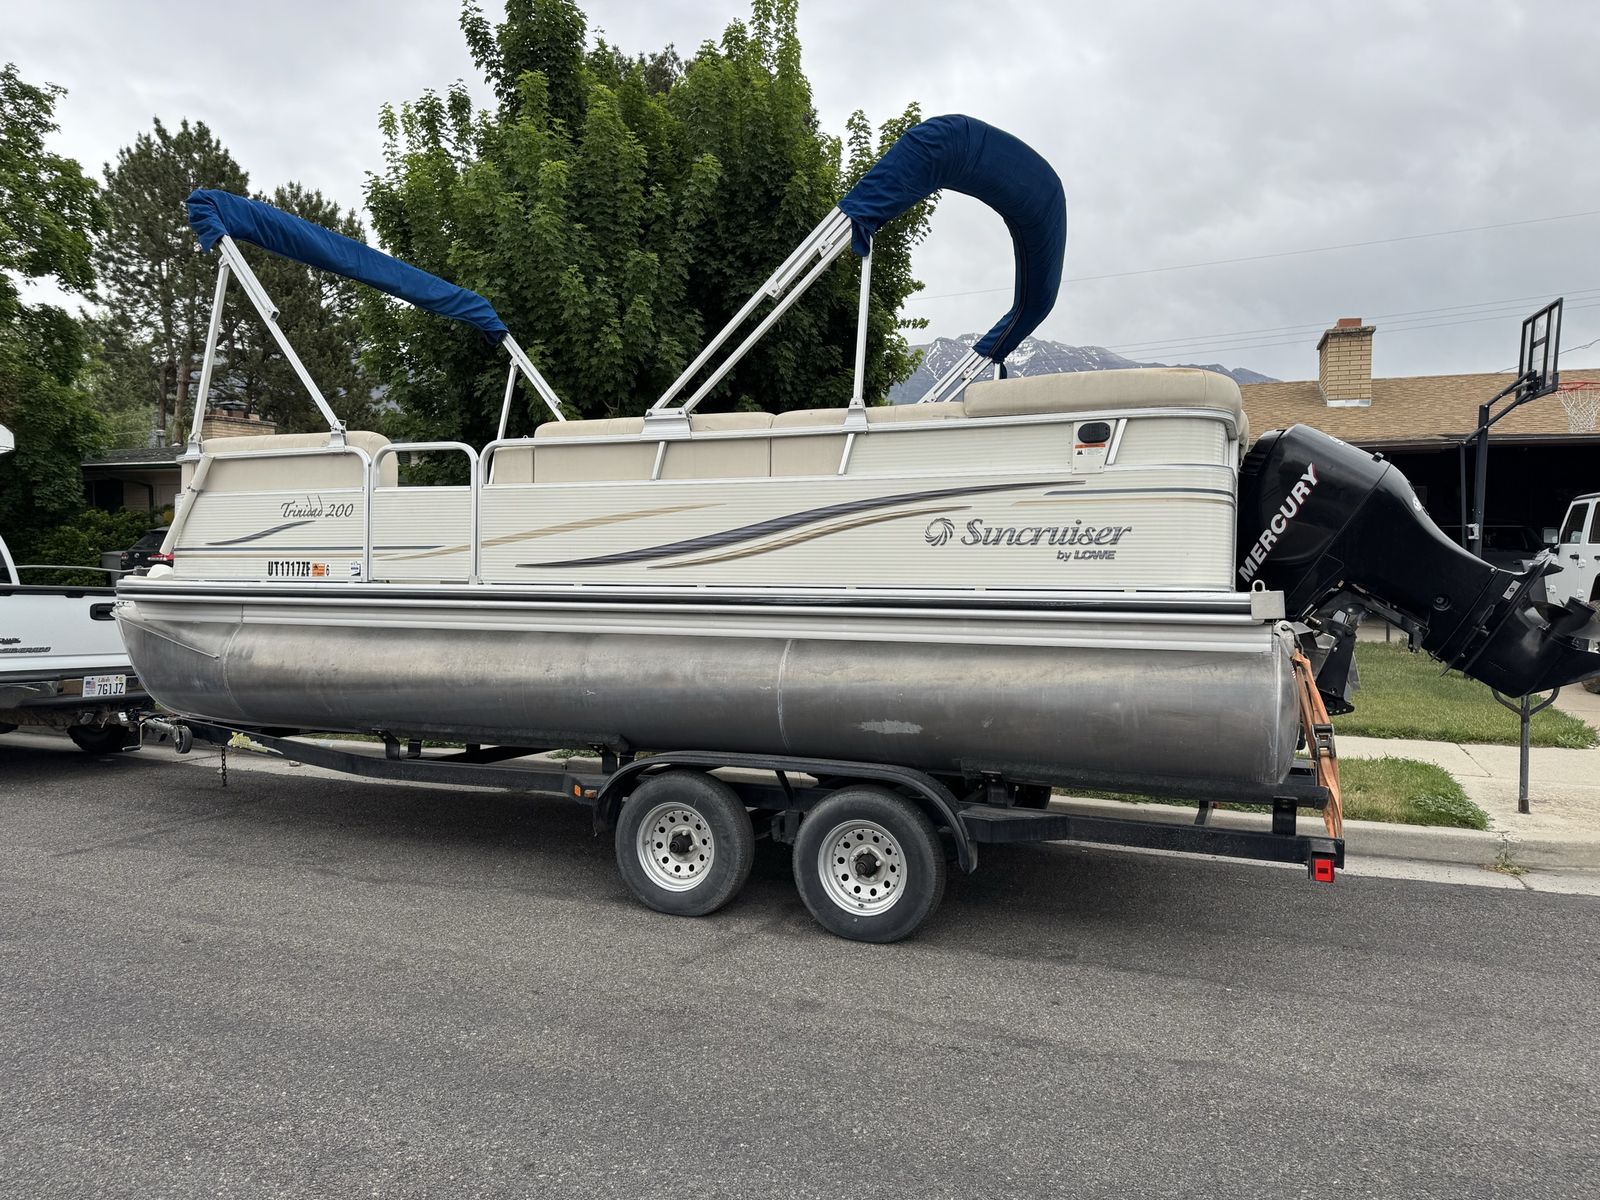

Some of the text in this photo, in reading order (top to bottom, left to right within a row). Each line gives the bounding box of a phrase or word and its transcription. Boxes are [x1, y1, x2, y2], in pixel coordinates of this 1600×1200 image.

[281, 494, 354, 518] Trinidad 200
[961, 518, 1132, 546] Suncruiser
[1239, 462, 1319, 582] MERCURY
[1056, 550, 1117, 562] by LOWE
[97, 682, 124, 696] 7G1JZ
